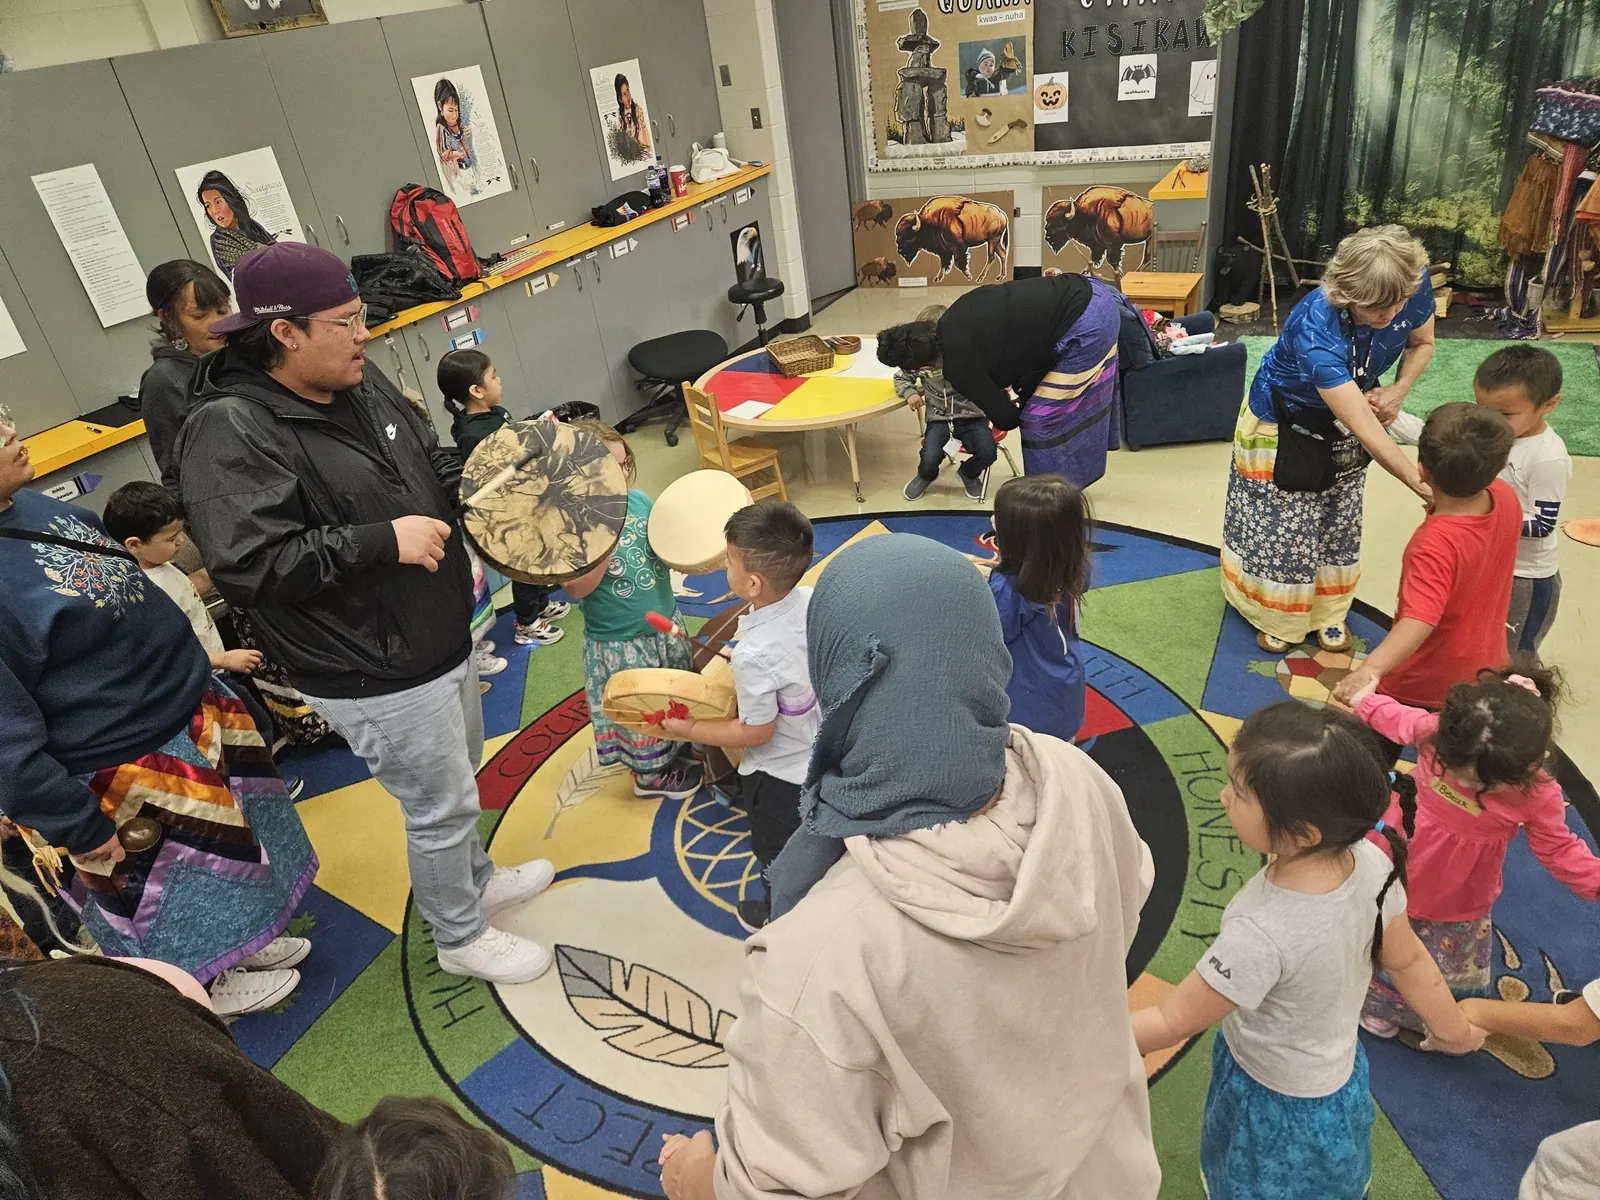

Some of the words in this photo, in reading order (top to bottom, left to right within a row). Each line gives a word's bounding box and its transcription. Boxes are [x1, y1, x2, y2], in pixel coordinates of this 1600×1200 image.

[979, 15, 998, 24] kwaa
[1005, 11, 1024, 21] nuha
[499, 699, 589, 778] COUR
[1209, 956, 1232, 980] FILA
